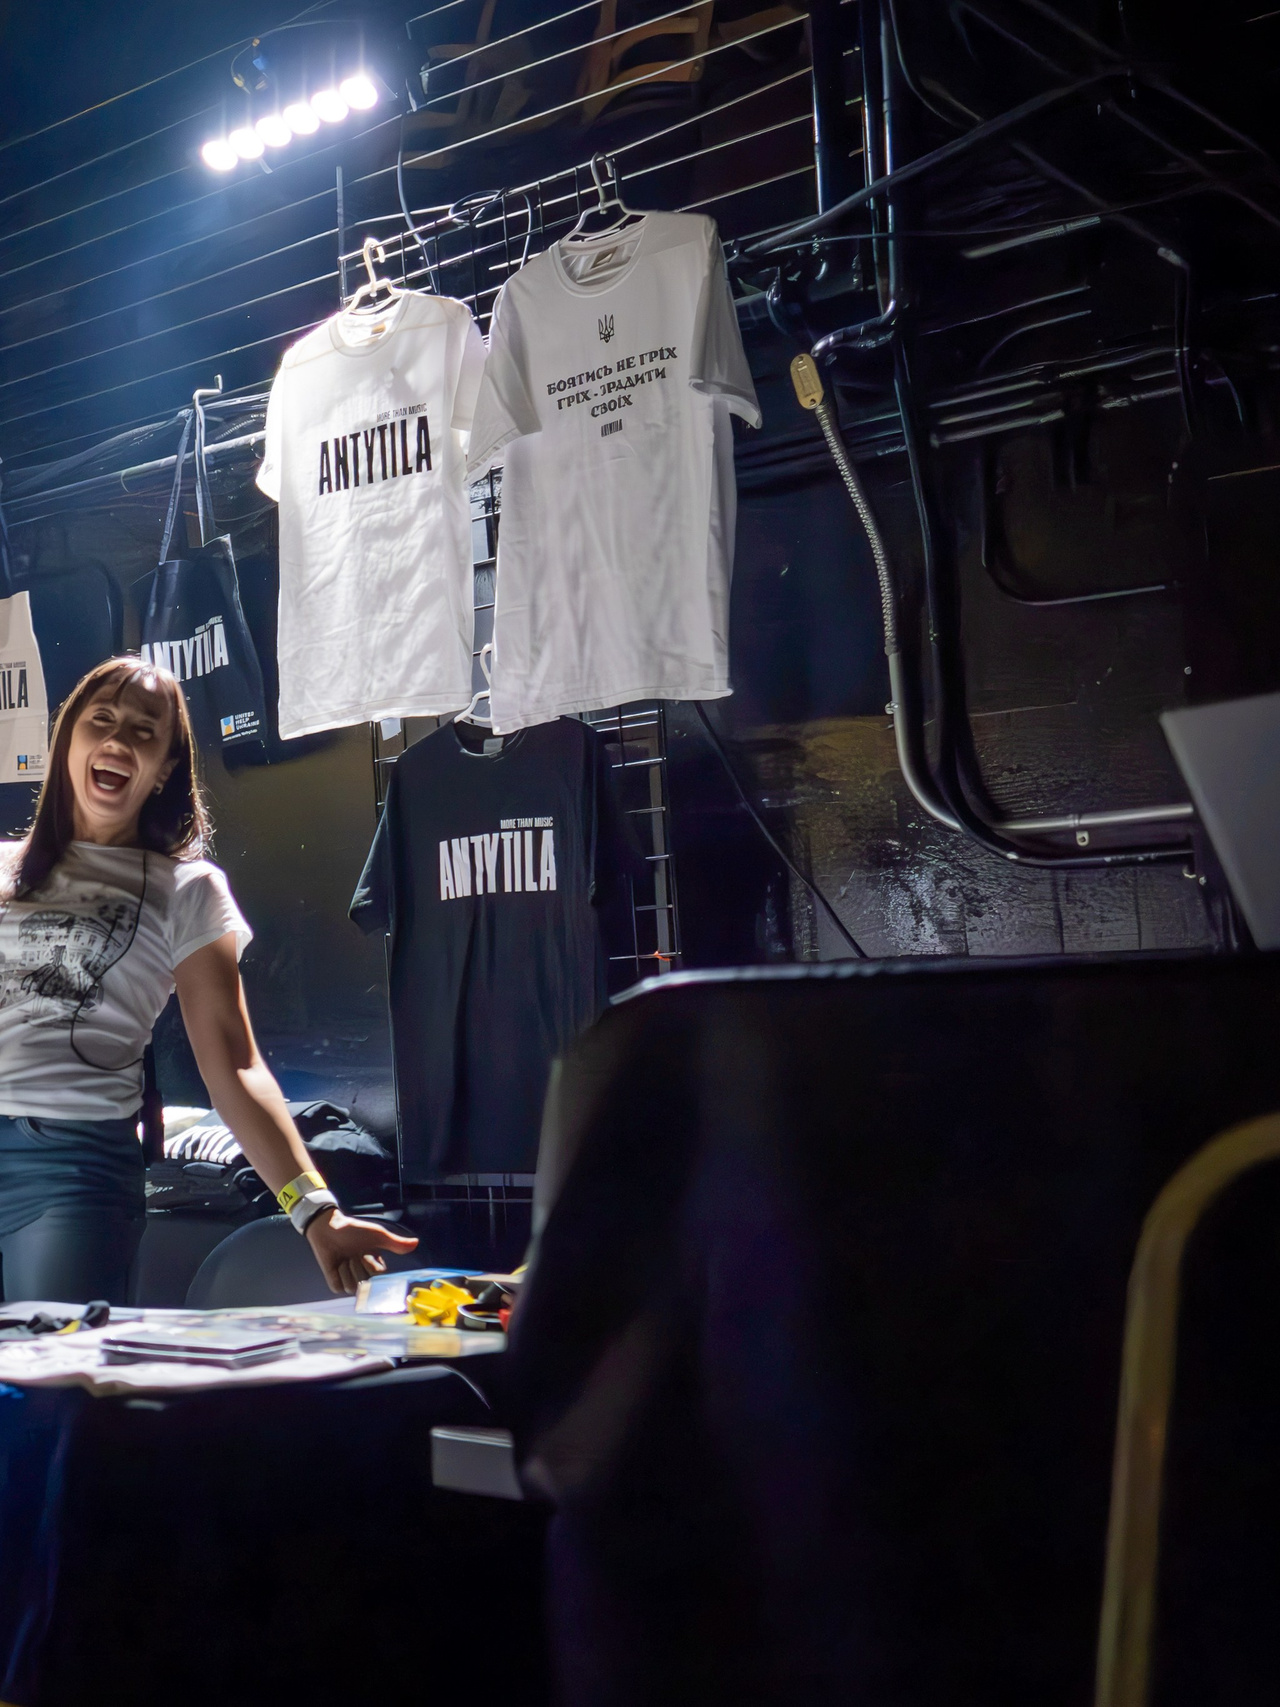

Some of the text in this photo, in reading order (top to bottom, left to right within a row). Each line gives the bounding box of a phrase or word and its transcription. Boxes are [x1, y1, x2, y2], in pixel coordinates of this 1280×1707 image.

[546, 346, 678, 396] БОЯТИСЬ НЕ ГРІХ
[557, 389, 592, 411] ГРІХ
[319, 415, 433, 496] ANTYTILA
[500, 816, 553, 829] MORE THAN MUSIC
[439, 829, 557, 901] ANTYTILA
